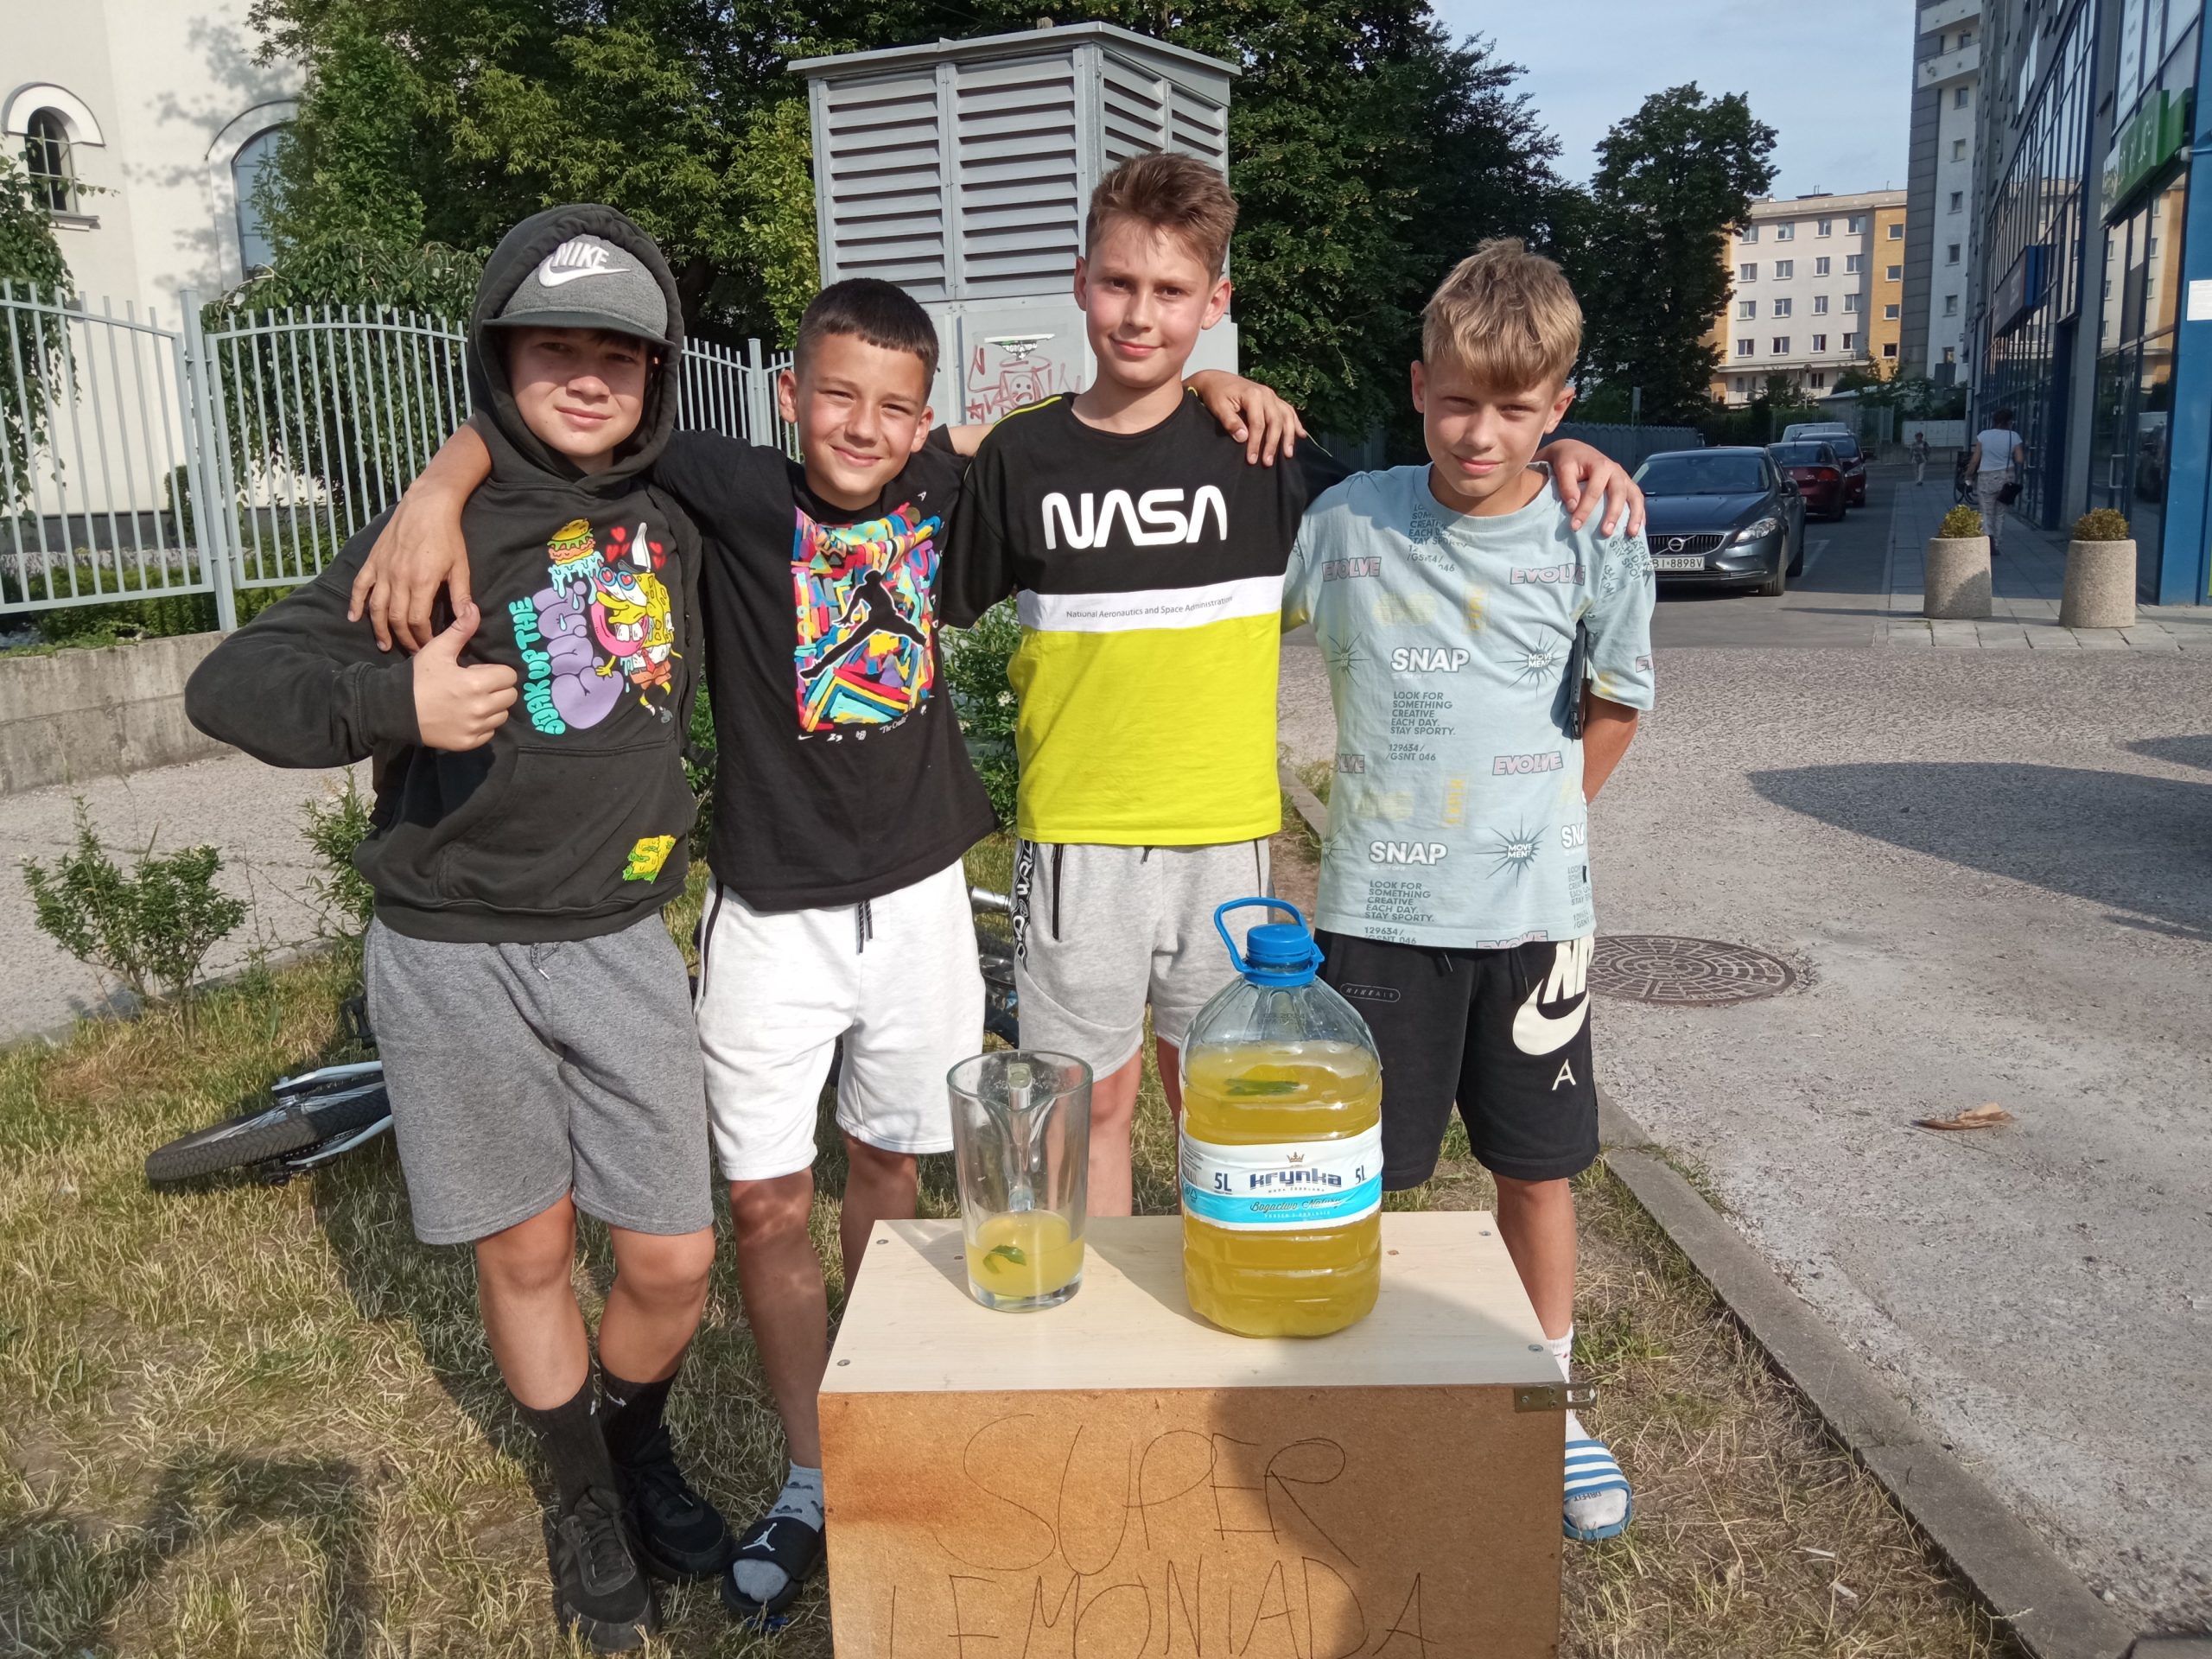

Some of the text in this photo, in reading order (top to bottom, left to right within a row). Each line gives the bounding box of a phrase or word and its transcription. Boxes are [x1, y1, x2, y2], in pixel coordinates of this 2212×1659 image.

[551, 241, 609, 268] NIKE
[1041, 485, 1228, 550] NASA
[1408, 528, 1433, 537] EACH
[1670, 558, 1703, 568] 8898V
[1066, 610, 1098, 619] National
[1099, 608, 1143, 618] Aeronautics
[1160, 605, 1184, 615] Space
[1185, 595, 1233, 612] Administration
[1390, 646, 1471, 673] SNAP
[509, 596, 566, 734] SOAK UP THE
[1393, 691, 1444, 700] LOOK FOR
[1392, 700, 1453, 709] SOMETHING
[1391, 709, 1435, 718] CREATIVE
[1391, 718, 1440, 727] EACH DAY.
[1414, 727, 1457, 735] SPORTY.
[1418, 753, 1437, 761] 046
[1336, 753, 1365, 774] LVE
[1492, 751, 1564, 776] EVOLVE
[1509, 842, 1533, 851] MOVE
[1369, 840, 1448, 866] SNAP
[1507, 849, 1532, 858] MENT
[1370, 880, 1422, 891] LOOK FOR
[1368, 888, 1432, 899] SOMETHING
[1367, 896, 1414, 906] CREATIVE
[1365, 904, 1419, 914] EACH DAY.
[1364, 912, 1435, 923] STAY SPORTY.
[1345, 988, 1374, 996] NIKE
[1214, 1172, 1232, 1192] 5L
[1355, 1165, 1367, 1185] 5L
[933, 1414, 1360, 1577] SUPER
